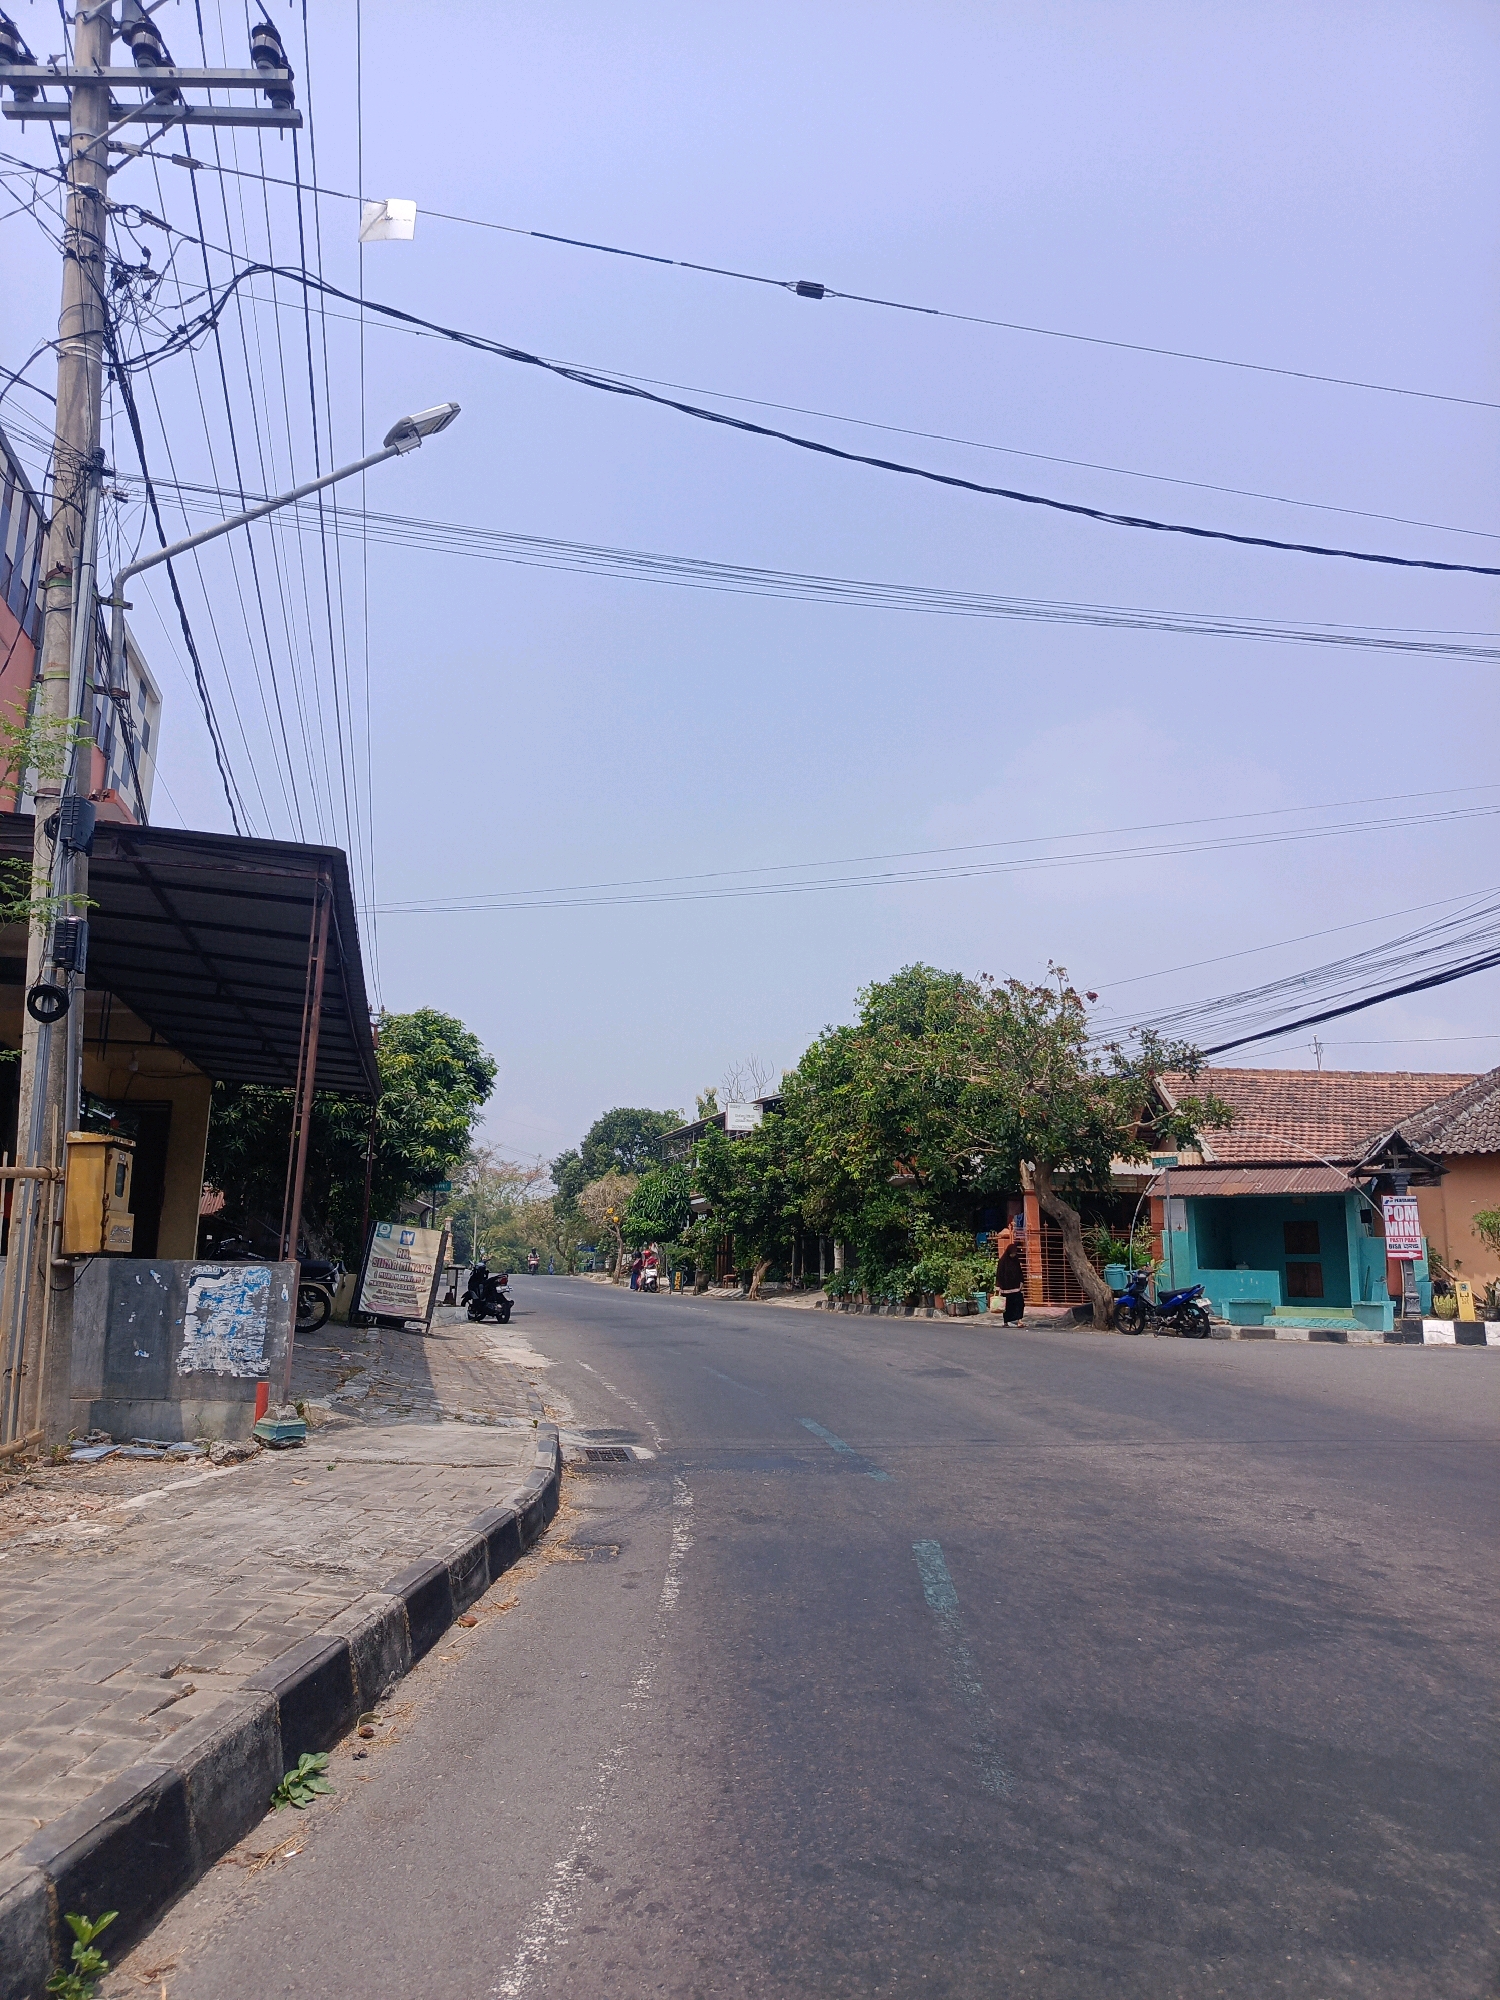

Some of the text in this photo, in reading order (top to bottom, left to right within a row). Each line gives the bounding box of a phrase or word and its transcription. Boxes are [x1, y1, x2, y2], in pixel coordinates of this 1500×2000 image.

[1384, 1206, 1419, 1221] POM
[1385, 1222, 1420, 1236] MINI
[400, 1261, 432, 1275] MINANG
